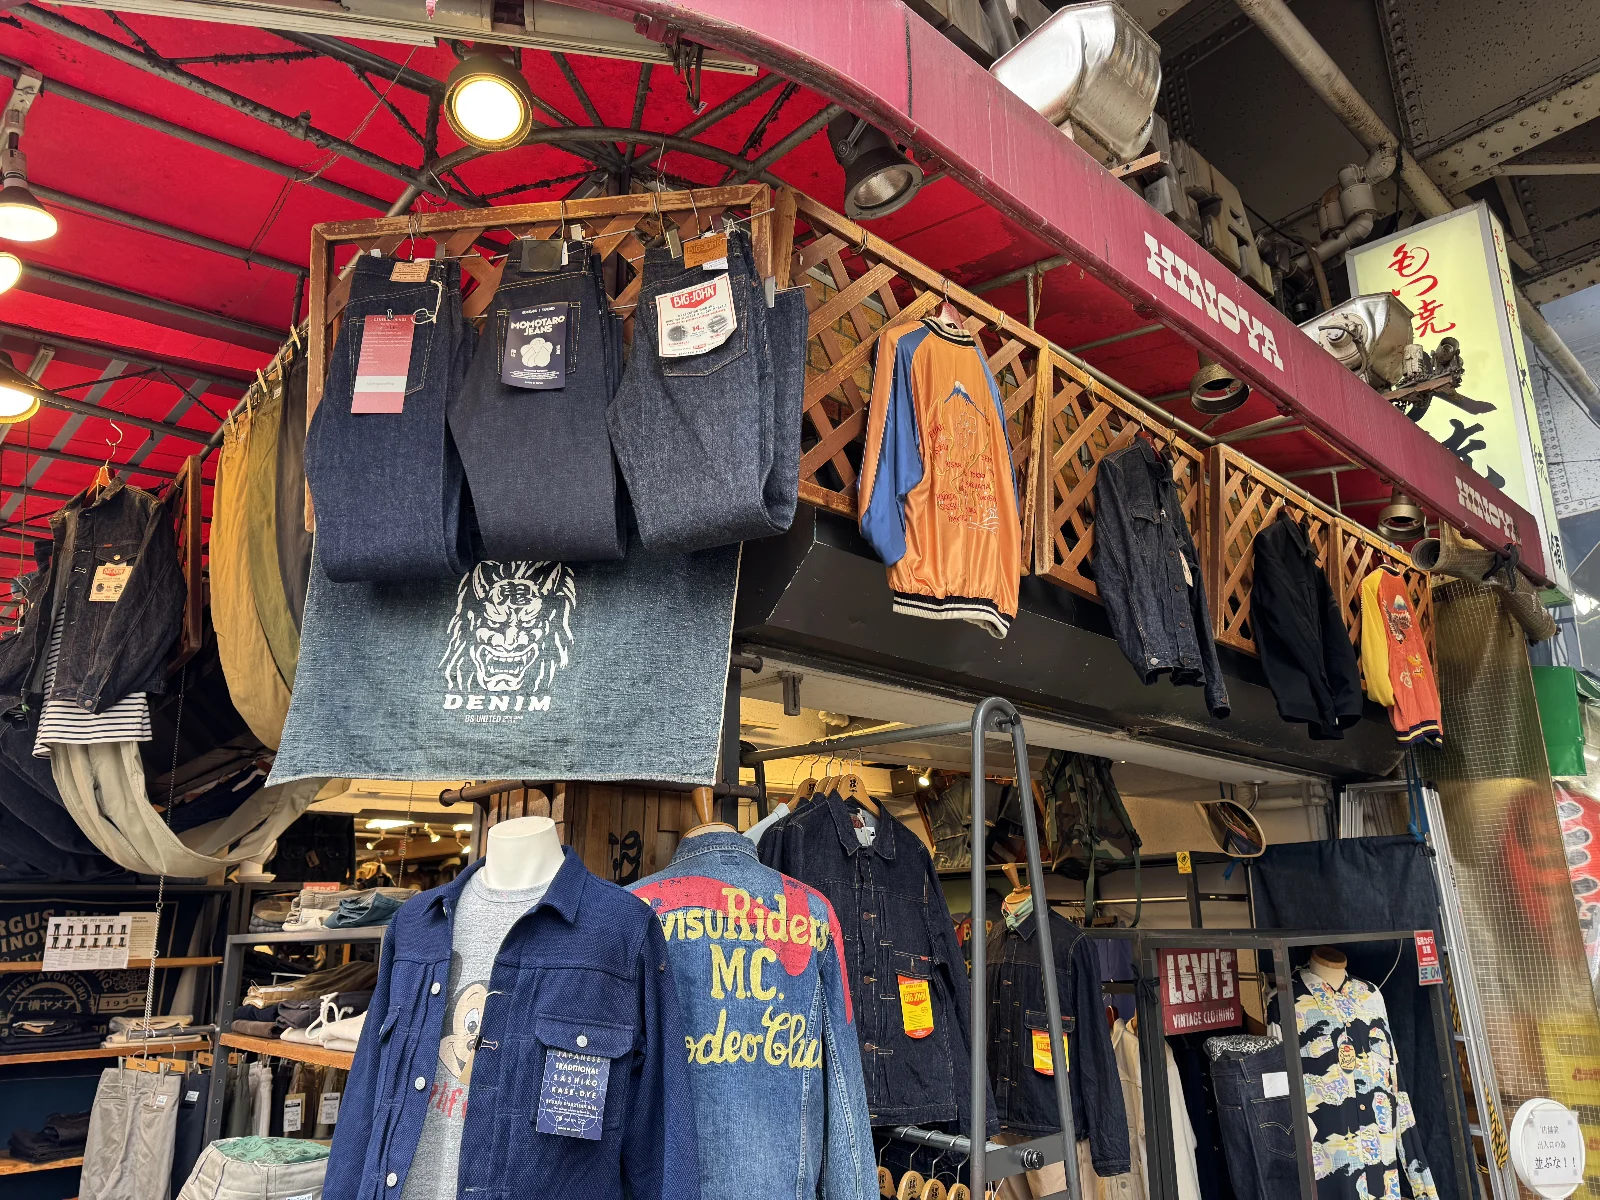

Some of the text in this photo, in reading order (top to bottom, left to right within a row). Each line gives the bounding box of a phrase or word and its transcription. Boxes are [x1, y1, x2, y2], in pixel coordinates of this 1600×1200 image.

[673, 285, 716, 308] BIG-JOHN
[1144, 231, 1284, 372] HINOYA
[510, 315, 567, 330] MOMOTARO
[523, 325, 553, 336] JEANS
[443, 694, 551, 711] DENIM
[476, 714, 502, 723] UNITED
[709, 944, 785, 1001] M.C.
[1166, 949, 1235, 1005] LEVI'S
[1172, 1007, 1235, 1029] VINTAGE CLOTHING
[556, 1051, 601, 1063] JAPANESE
[555, 1062, 599, 1075] TRADITIONAL
[553, 1073, 598, 1087] SASHIKO
[551, 1086, 597, 1099] KASE-DYE
